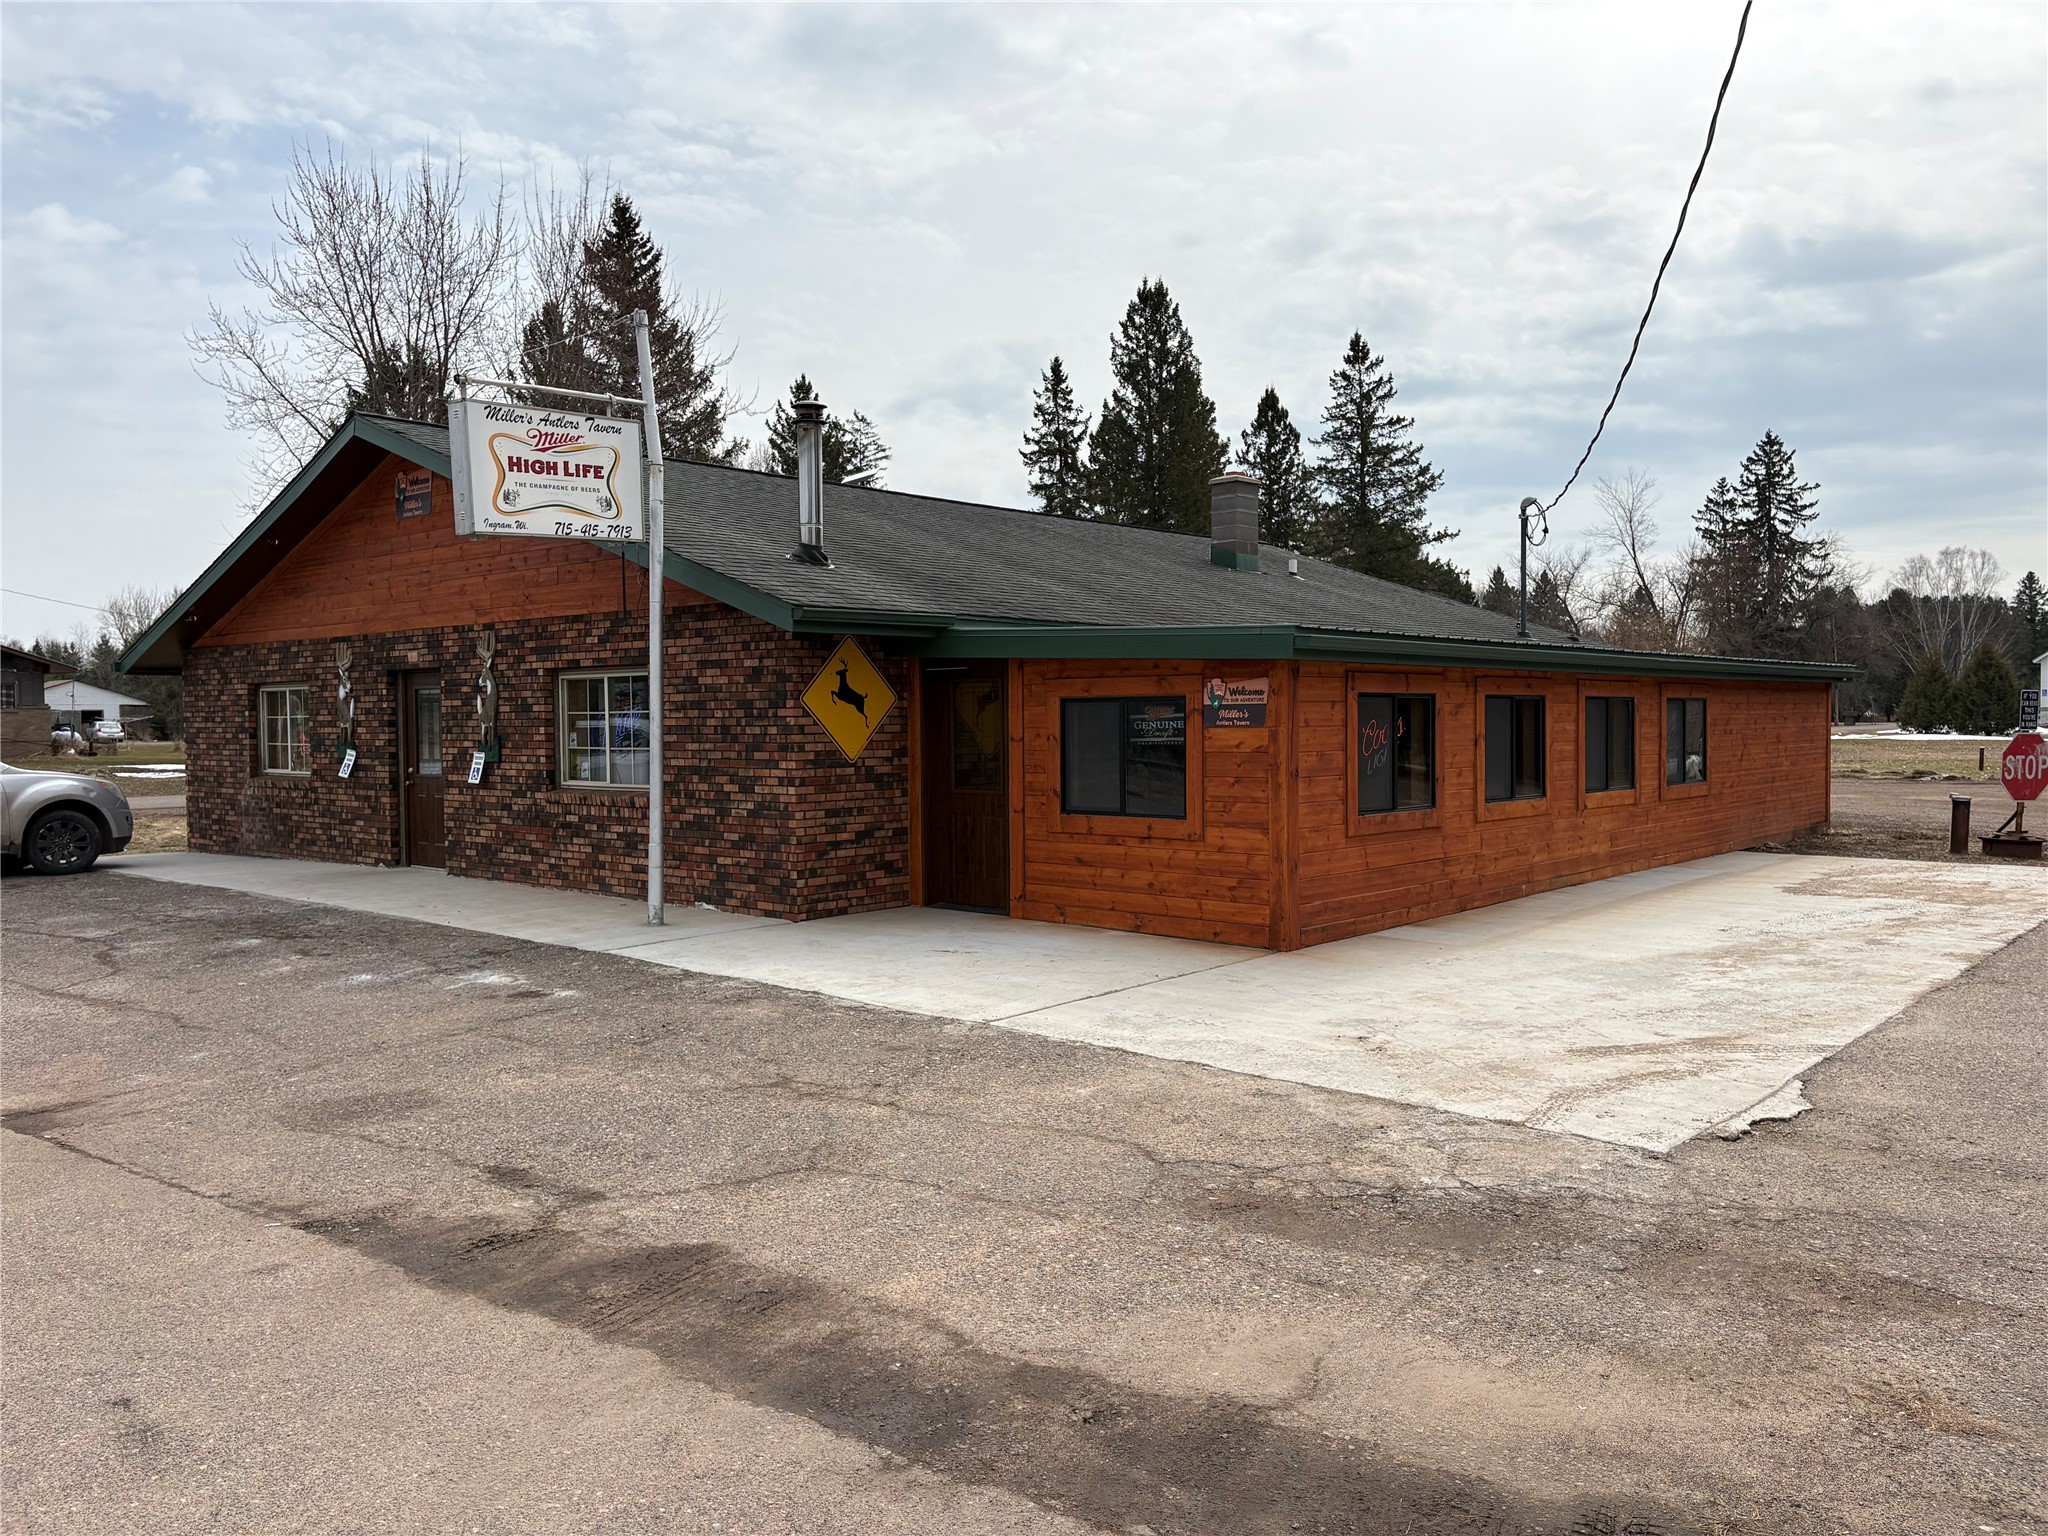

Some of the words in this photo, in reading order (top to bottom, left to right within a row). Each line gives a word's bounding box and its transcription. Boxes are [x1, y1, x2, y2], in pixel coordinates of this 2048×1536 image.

[484, 405, 534, 425] Miller's
[536, 412, 580, 430] Antlers
[584, 416, 623, 435] Tavern
[526, 428, 585, 449] Miller
[507, 456, 559, 476] HIGH
[563, 460, 605, 479] LIFE
[529, 482, 569, 491] CHAMPAGNE
[580, 486, 601, 494] BEERS
[554, 522, 633, 539] 715-415-7913
[1228, 685, 1265, 697] Welcome
[1218, 709, 1250, 719] Miller's
[1133, 720, 1184, 729] GENUINE
[1144, 728, 1175, 739] Draft
[2004, 754, 2048, 780] STOP
